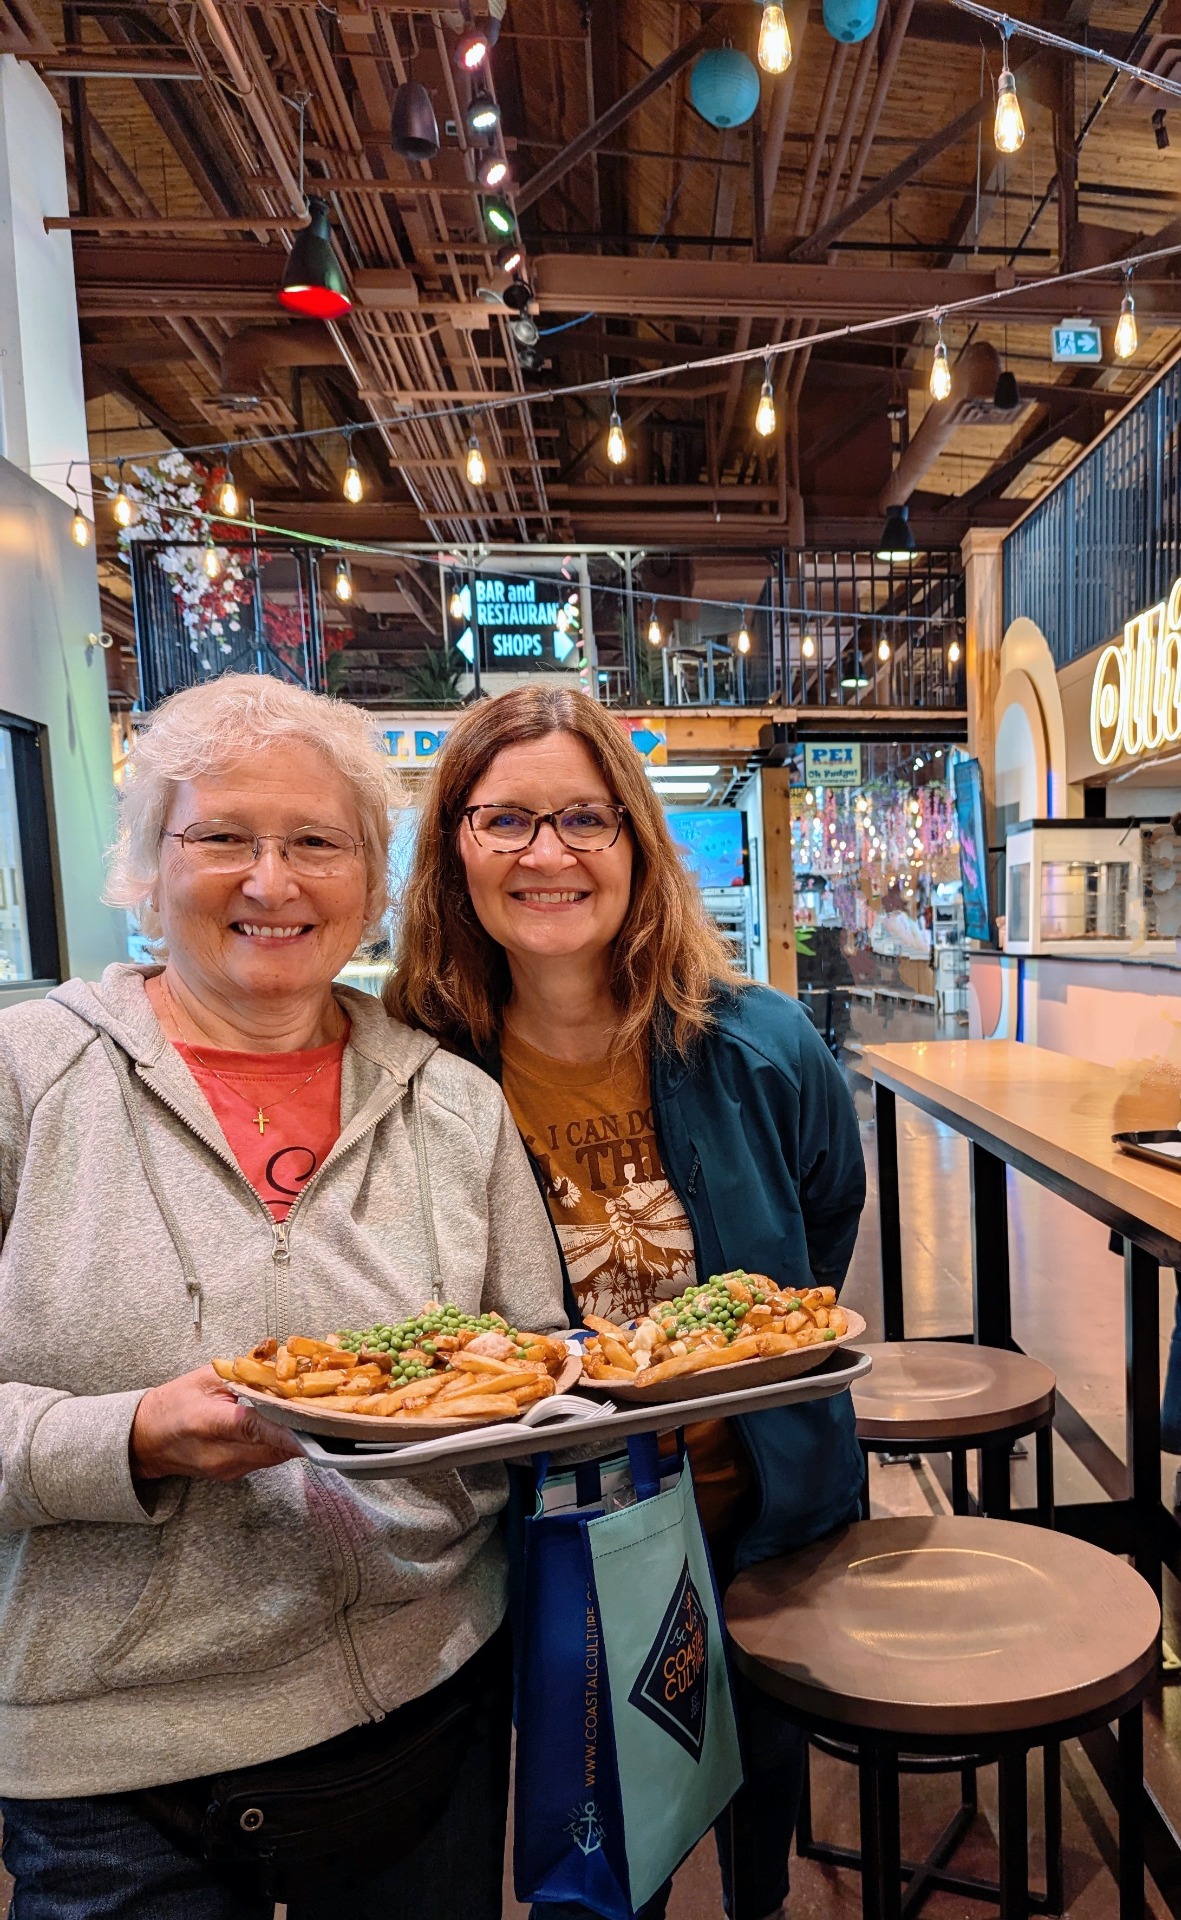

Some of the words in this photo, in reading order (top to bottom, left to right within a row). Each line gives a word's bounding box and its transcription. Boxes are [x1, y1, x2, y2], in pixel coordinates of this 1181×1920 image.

[475, 580, 505, 603] BAR
[508, 580, 536, 603] and
[476, 602, 573, 626] RESTAURANS
[492, 633, 543, 657] SHOPS
[812, 748, 853, 762] PEI
[548, 1125, 560, 1150] I
[566, 1114, 620, 1147] CAN
